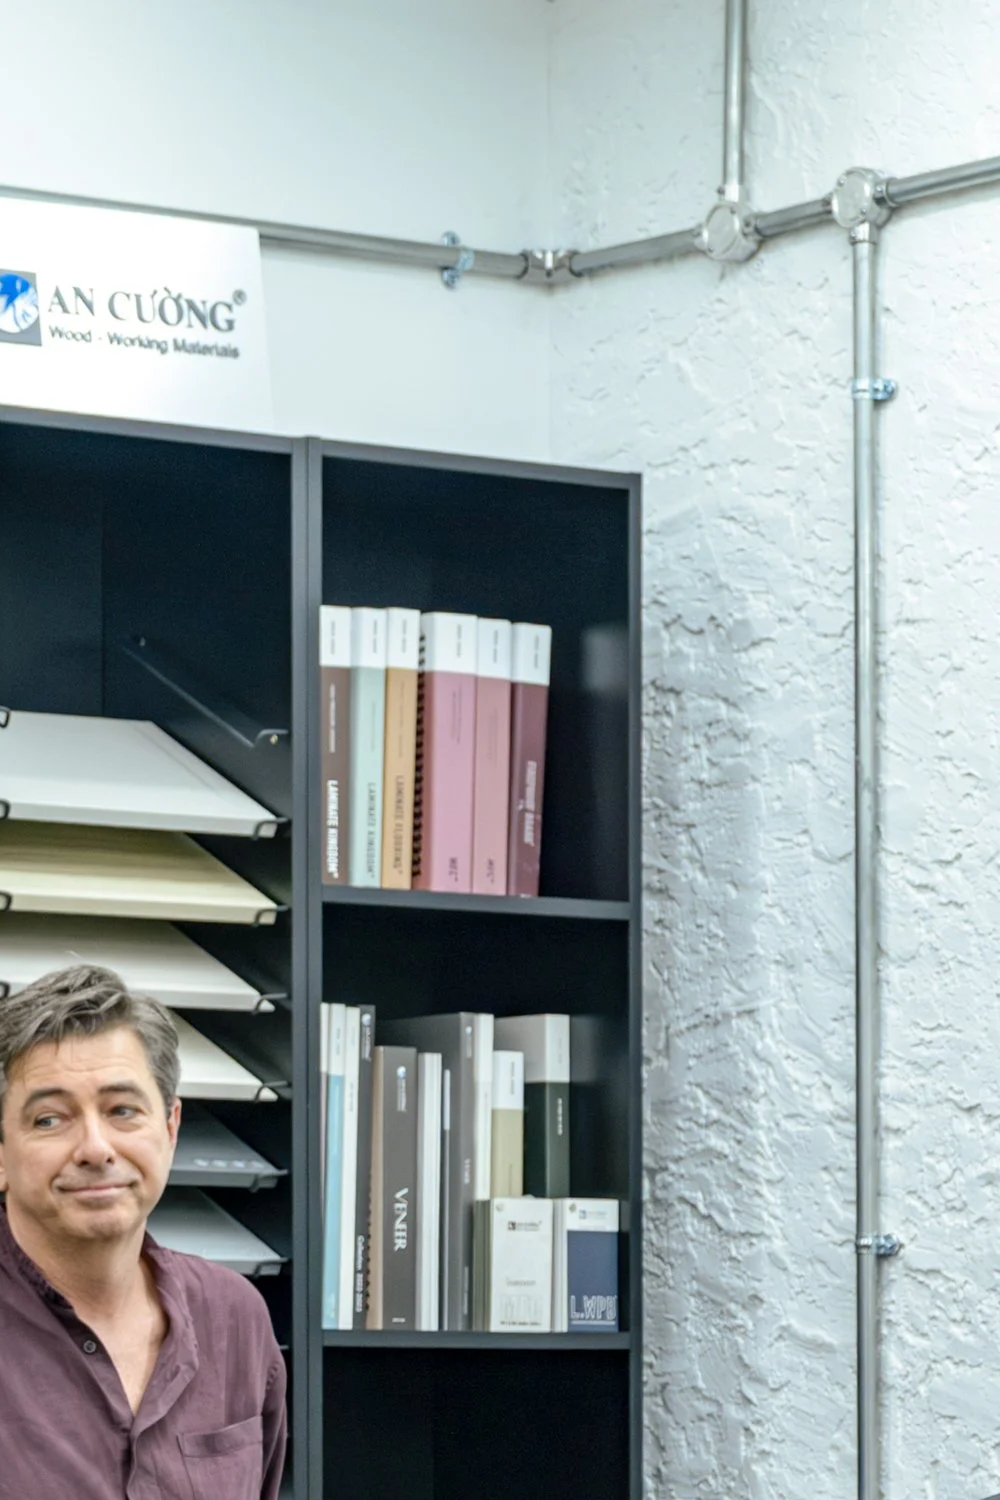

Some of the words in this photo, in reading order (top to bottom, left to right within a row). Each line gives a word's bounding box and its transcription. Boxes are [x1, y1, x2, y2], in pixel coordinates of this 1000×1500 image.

[48, 285, 95, 316] AN
[49, 325, 92, 343] Wood
[107, 332, 168, 355] Working
[173, 338, 240, 359] Materials
[394, 1187, 409, 1252] VENEER
